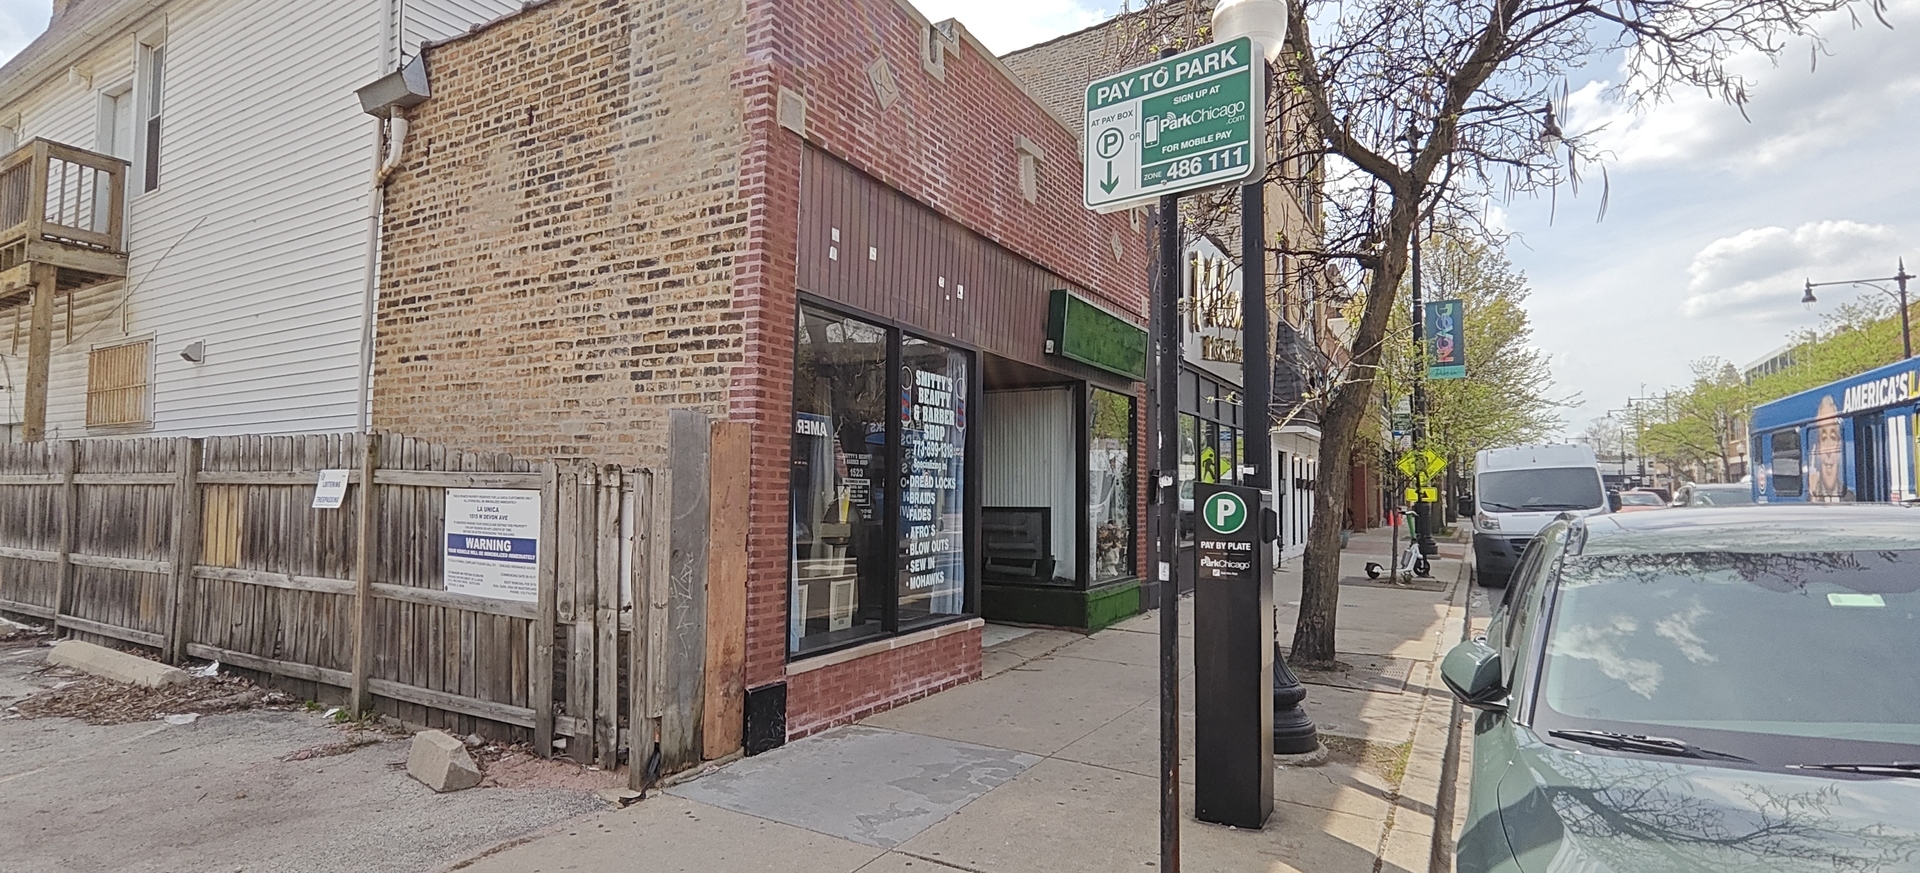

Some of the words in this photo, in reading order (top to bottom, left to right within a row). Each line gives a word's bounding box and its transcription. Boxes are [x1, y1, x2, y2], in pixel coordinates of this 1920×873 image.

[1098, 78, 1135, 105] PAY
[1140, 68, 1169, 92] TO
[1176, 46, 1237, 82] PARK
[1173, 92, 1194, 105] SIGN
[1196, 89, 1207, 99] UP
[1208, 85, 1220, 95] AT
[1091, 118, 1100, 127] AT
[1102, 115, 1116, 125] PAY
[1117, 110, 1134, 121] BOX
[1160, 100, 1245, 132] ParkChicago
[1226, 114, 1245, 125] .com
[1103, 133, 1118, 154] P
[1130, 132, 1140, 141] OR
[1162, 143, 1179, 154] FOR
[1180, 135, 1214, 150] MOBILE
[1215, 130, 1232, 141] PAY
[1144, 171, 1162, 180] ZONE
[1167, 158, 1202, 179] 486
[1209, 147, 1242, 170] 111
[916, 370, 953, 392] SMITTY'S
[918, 387, 950, 409] BEAUTY
[1843, 372, 1908, 413] AMERICA'S
[1908, 370, 1920, 400] L
[914, 404, 921, 420] &
[922, 406, 954, 426] BARBER
[924, 424, 945, 441] SHOP
[850, 468, 863, 477] 1523
[910, 474, 934, 488] DREAD
[934, 477, 956, 489] LOCKS
[909, 492, 936, 504] BRAIDS
[909, 508, 932, 521] FADES
[1217, 499, 1236, 526] P
[910, 524, 936, 539] AFRO'S
[466, 537, 511, 552] WARNING
[910, 541, 930, 556] BLOW
[932, 538, 949, 552] OUTS
[1200, 541, 1215, 549] PAY
[1216, 541, 1226, 549] BY
[1228, 542, 1251, 550] PLATE
[910, 560, 926, 572] SEW
[927, 557, 935, 569] IN
[1200, 558, 1250, 570] ParkChicago
[910, 572, 944, 590] MOHAWKS
